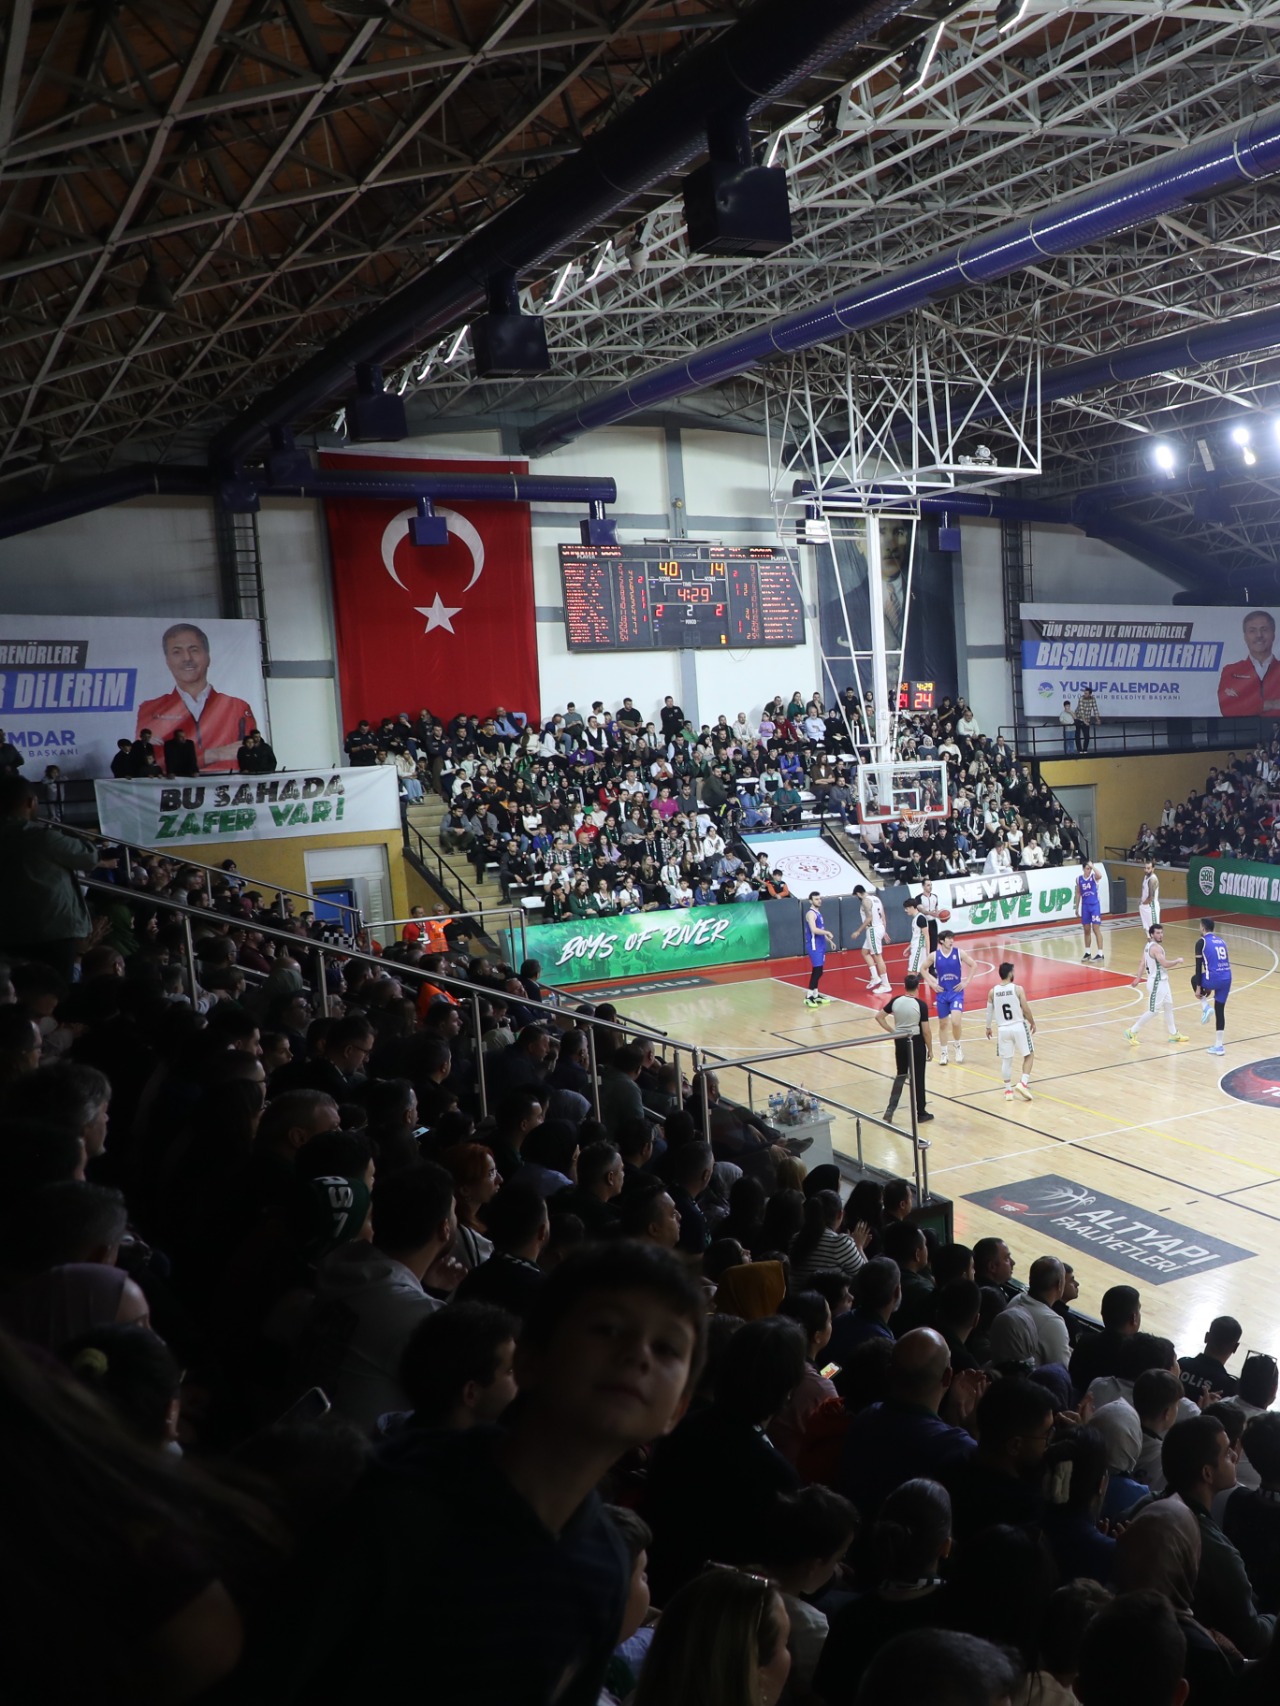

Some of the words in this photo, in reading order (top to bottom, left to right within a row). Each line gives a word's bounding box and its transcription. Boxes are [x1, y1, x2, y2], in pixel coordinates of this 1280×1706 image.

[658, 561, 678, 576] 40
[710, 562, 724, 576] 14
[677, 588, 709, 602] 4:29
[655, 604, 664, 617] 2
[686, 604, 693, 616] 2
[715, 603, 724, 616] 2
[1042, 621, 1062, 637] TÜM
[1064, 624, 1102, 638] SPORCU
[1104, 624, 1116, 638] VE
[1117, 623, 1188, 639] ANTRENÖRLERE
[1036, 642, 1141, 670] BAŞARILAR
[1143, 644, 1218, 668] DİLERİM
[13, 673, 128, 709] DİLERİM
[1059, 681, 1108, 693] YUSUF
[1109, 682, 1180, 693] ALEMDAR
[914, 693, 933, 709] 24
[1149, 693, 1181, 701] BAŞKANI
[29, 748, 79, 758] BAŞKANI
[159, 786, 206, 812] BU
[214, 775, 346, 808] SAHADA
[155, 808, 257, 839] ZAFER
[269, 797, 346, 827] VAR!
[954, 874, 1025, 906] NEVER
[1219, 872, 1269, 900] SAKARYA
[969, 892, 1032, 925] GIVE
[555, 931, 618, 966] BOYS
[624, 928, 659, 951] OF
[661, 917, 730, 949] RIVER
[1214, 946, 1227, 960] 19
[1002, 1003, 1013, 1021] 6
[1050, 1216, 1184, 1273] FAALİYETLERİ
[1074, 1209, 1222, 1266] ALTYAPI
[1180, 1371, 1213, 1391] OLİS
